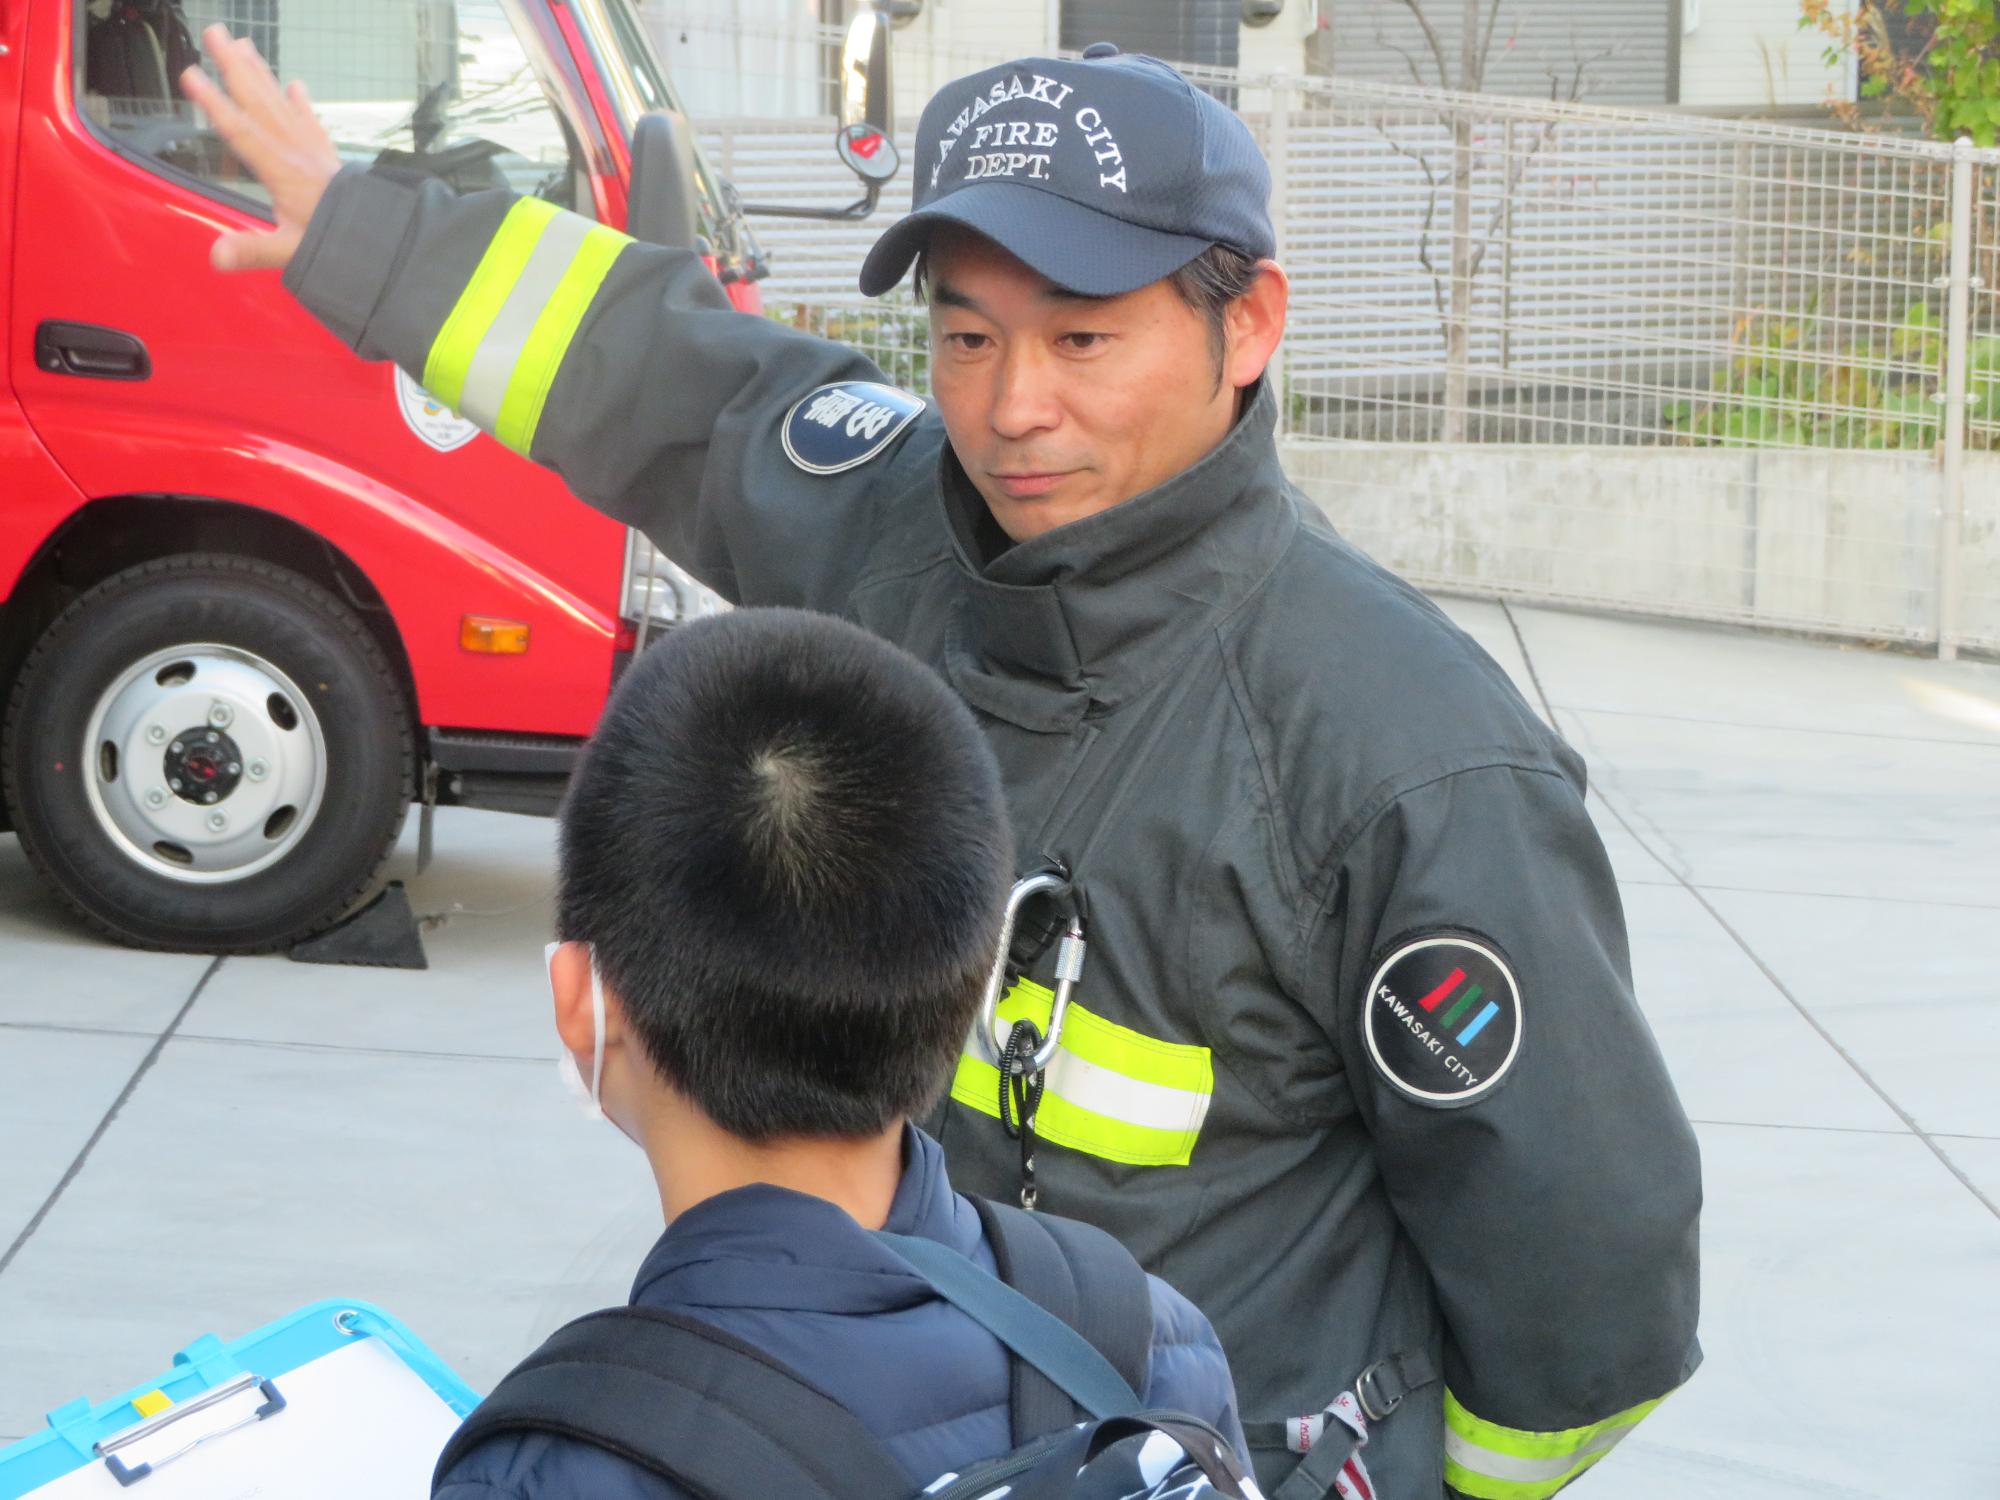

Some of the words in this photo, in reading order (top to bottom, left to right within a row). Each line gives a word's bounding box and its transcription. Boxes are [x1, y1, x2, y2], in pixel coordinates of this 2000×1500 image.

[930, 74, 1073, 189] KAWASAKI
[1075, 107, 1127, 192] CITY
[969, 121, 1059, 149] FIRE
[964, 153, 1050, 180] DEPT.
[1378, 984, 1444, 1055] KAWASAKI
[1444, 1055, 1478, 1086] CITY
